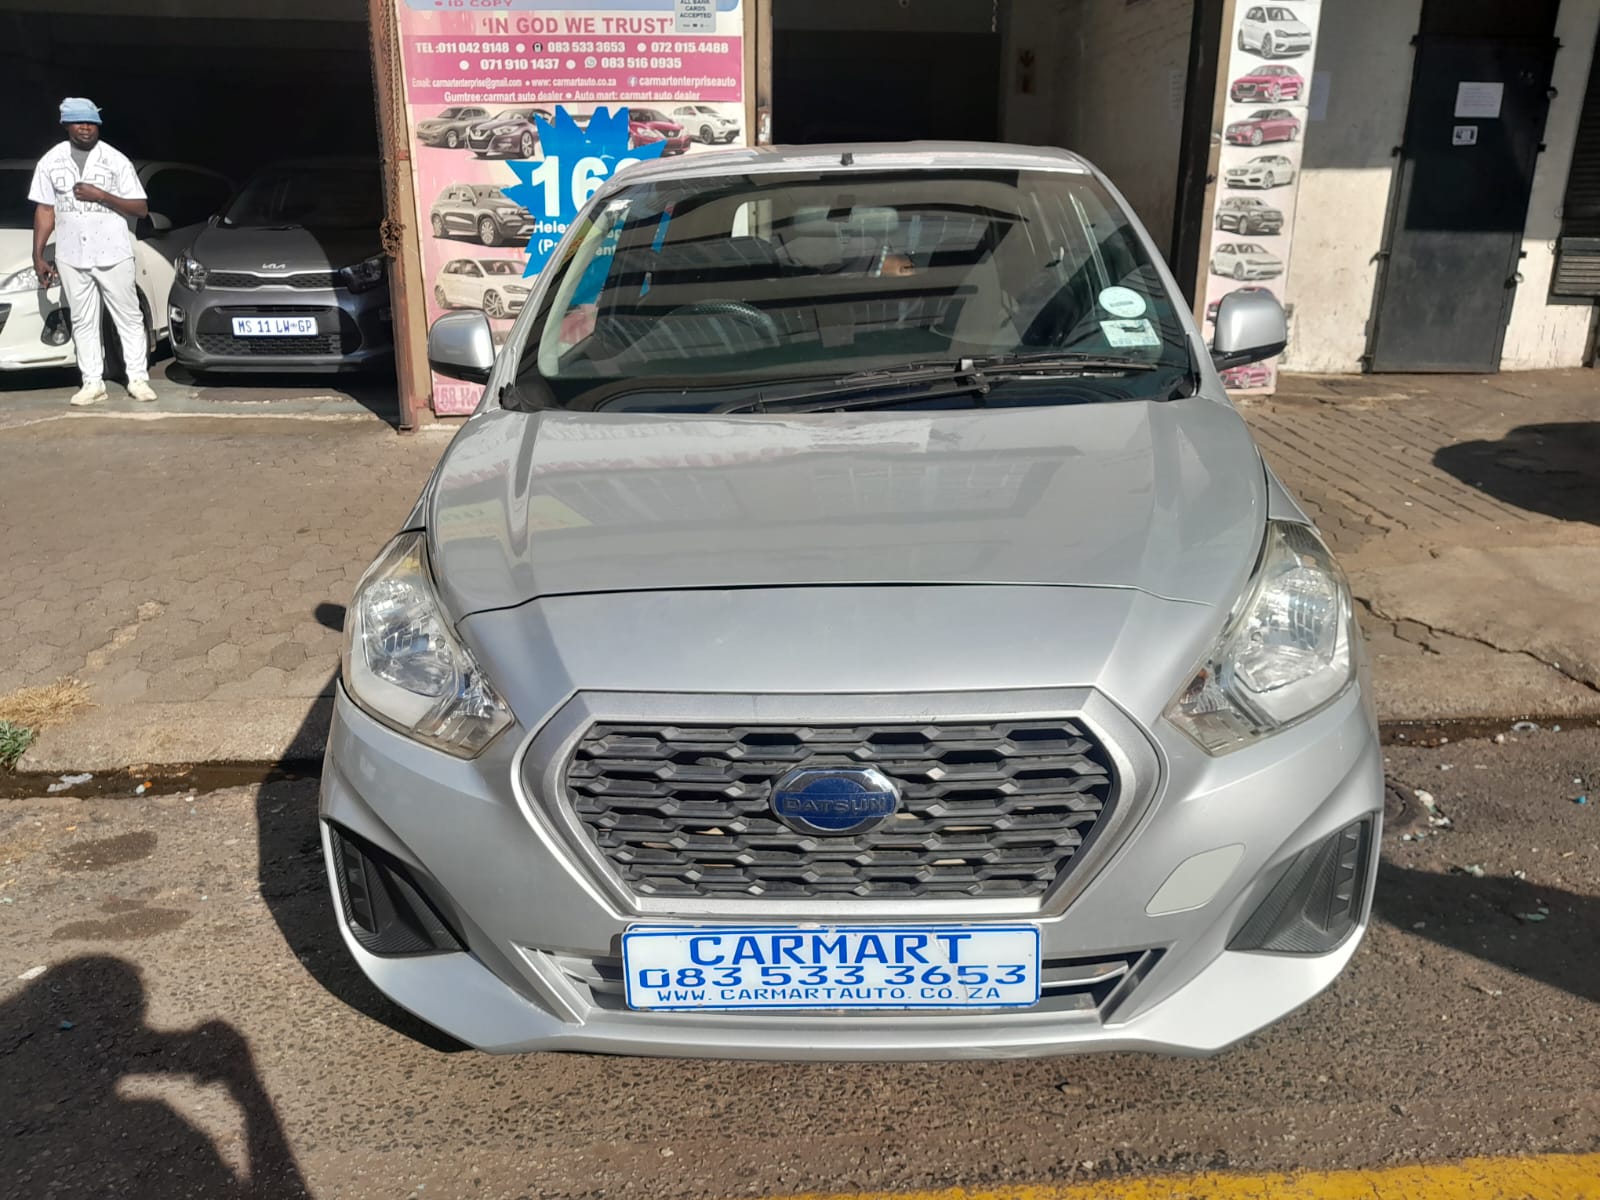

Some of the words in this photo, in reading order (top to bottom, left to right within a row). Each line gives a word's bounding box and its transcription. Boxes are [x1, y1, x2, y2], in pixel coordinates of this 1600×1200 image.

[516, 17, 558, 33] GOD
[565, 17, 595, 33] WE
[458, 43, 480, 53] 042
[482, 42, 509, 53] 9148
[547, 42, 568, 53] 083
[572, 42, 594, 52] 533
[596, 42, 625, 52] 3653
[651, 42, 672, 53] 072
[675, 42, 697, 53] 015
[698, 42, 729, 53] 4488
[480, 59, 502, 70] 071
[504, 59, 529, 70] 910
[531, 59, 559, 70] 1437
[601, 57, 624, 68] 083
[627, 57, 648, 68] 516
[651, 57, 682, 68] 0935
[517, 92, 536, 101] auto
[537, 91, 563, 101] dealer
[574, 90, 595, 100] Auto
[620, 91, 651, 100] carmart
[653, 91, 673, 100] auto
[674, 90, 700, 100] dealer
[238, 320, 253, 333] MS
[257, 321, 271, 333] 11
[276, 321, 290, 333] LW
[298, 321, 312, 332] GP
[783, 797, 887, 814] DATSUN
[689, 934, 971, 966] CARMART
[639, 968, 742, 988] 083
[760, 966, 864, 987] 533
[885, 964, 1026, 985] 3653
